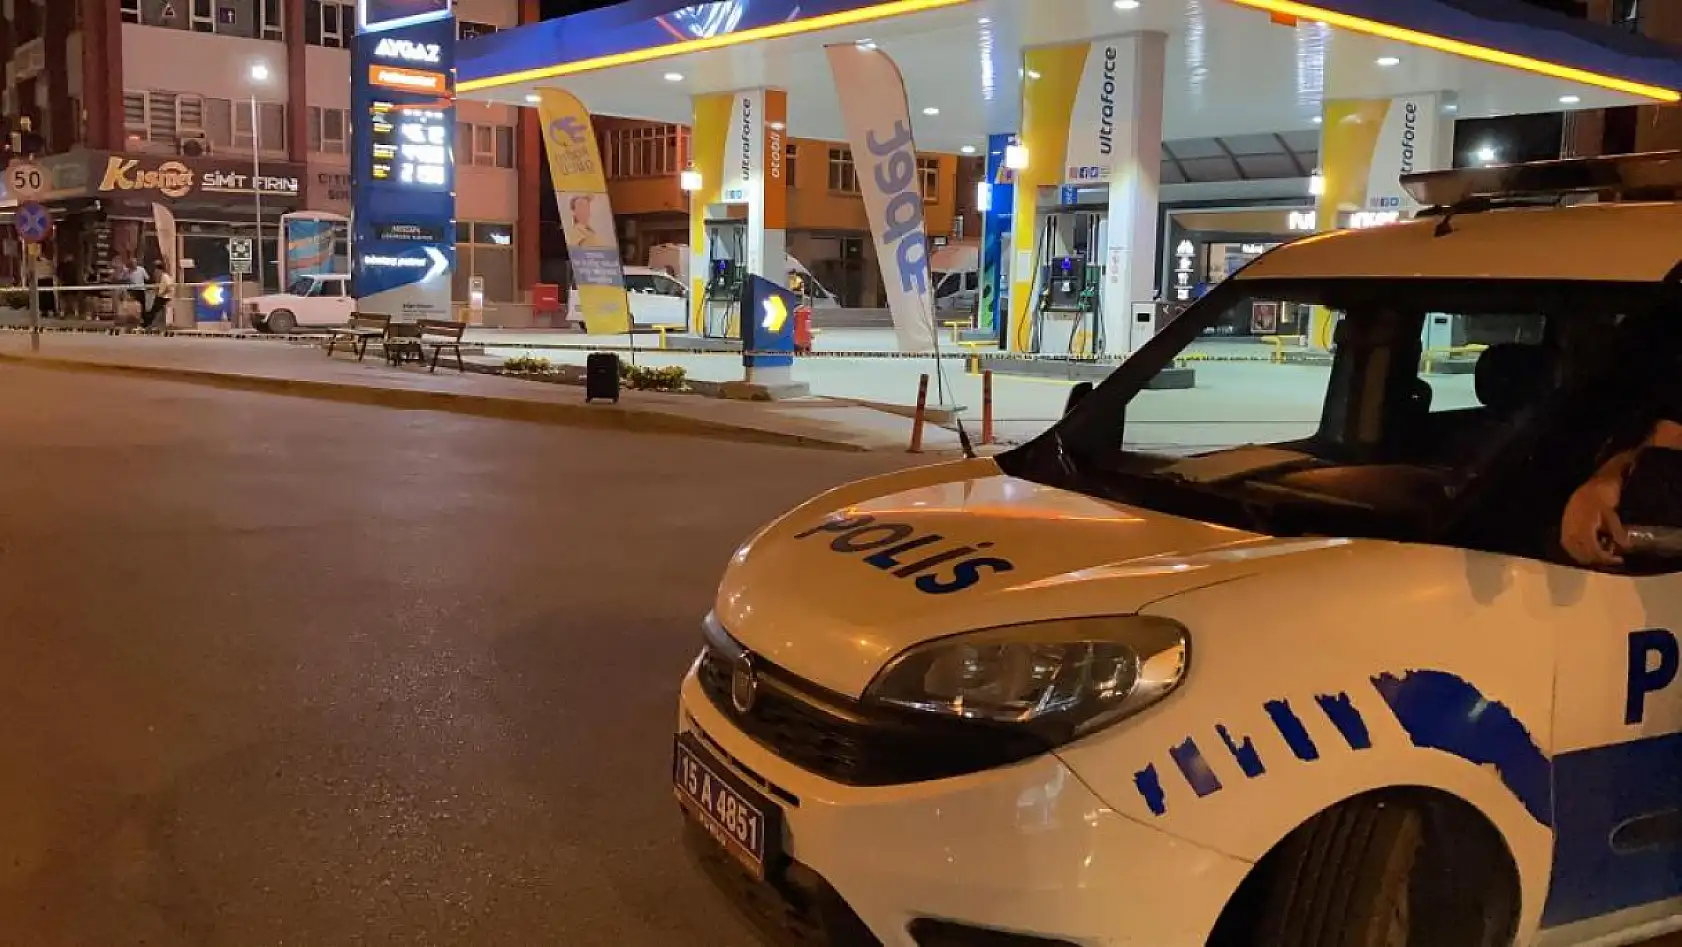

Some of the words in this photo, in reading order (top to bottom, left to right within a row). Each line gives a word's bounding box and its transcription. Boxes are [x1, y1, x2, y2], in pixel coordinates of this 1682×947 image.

[741, 98, 752, 182] ultraforce
[1100, 46, 1117, 155] ultraforce
[1400, 102, 1417, 174] traforce
[14, 170, 41, 190] 50
[794, 513, 1014, 594] POLİS
[1624, 629, 1680, 725] P
[681, 755, 698, 796] 15
[701, 772, 712, 812] A
[716, 788, 757, 850] 4851
